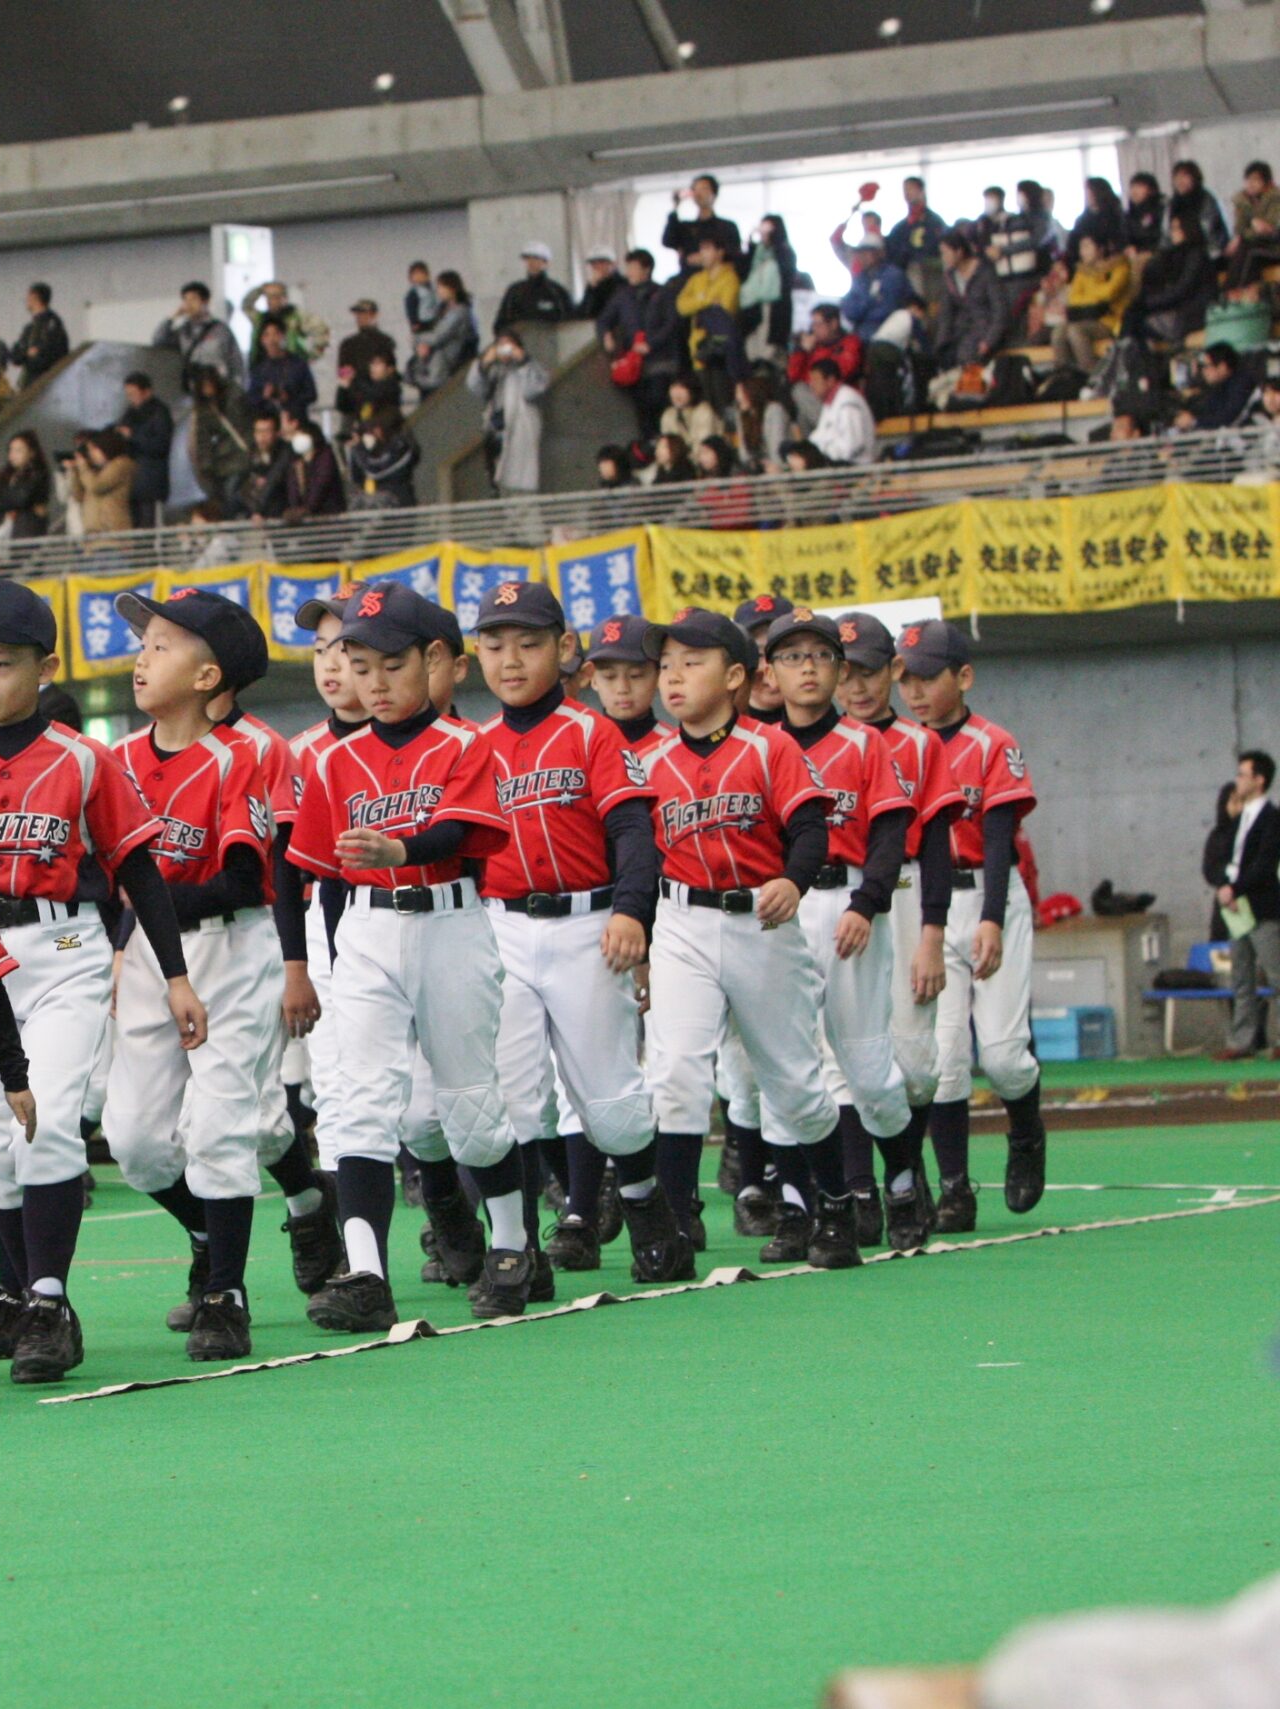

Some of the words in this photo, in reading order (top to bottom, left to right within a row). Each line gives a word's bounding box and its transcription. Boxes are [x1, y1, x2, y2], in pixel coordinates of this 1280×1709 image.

[980, 543, 1063, 573] 交通安全
[1081, 531, 1168, 570] 交通安全
[1185, 528, 1273, 560] 交通安全
[672, 569, 752, 600] 交通安全
[771, 568, 856, 600] 交通安全
[876, 547, 962, 590] 交通安全
[357, 591, 384, 618] S
[494, 581, 520, 606] S
[601, 621, 623, 645] S
[500, 767, 586, 807] GHTERS
[347, 783, 444, 830] FIGHTRS
[659, 793, 764, 848] FIGHTERS
